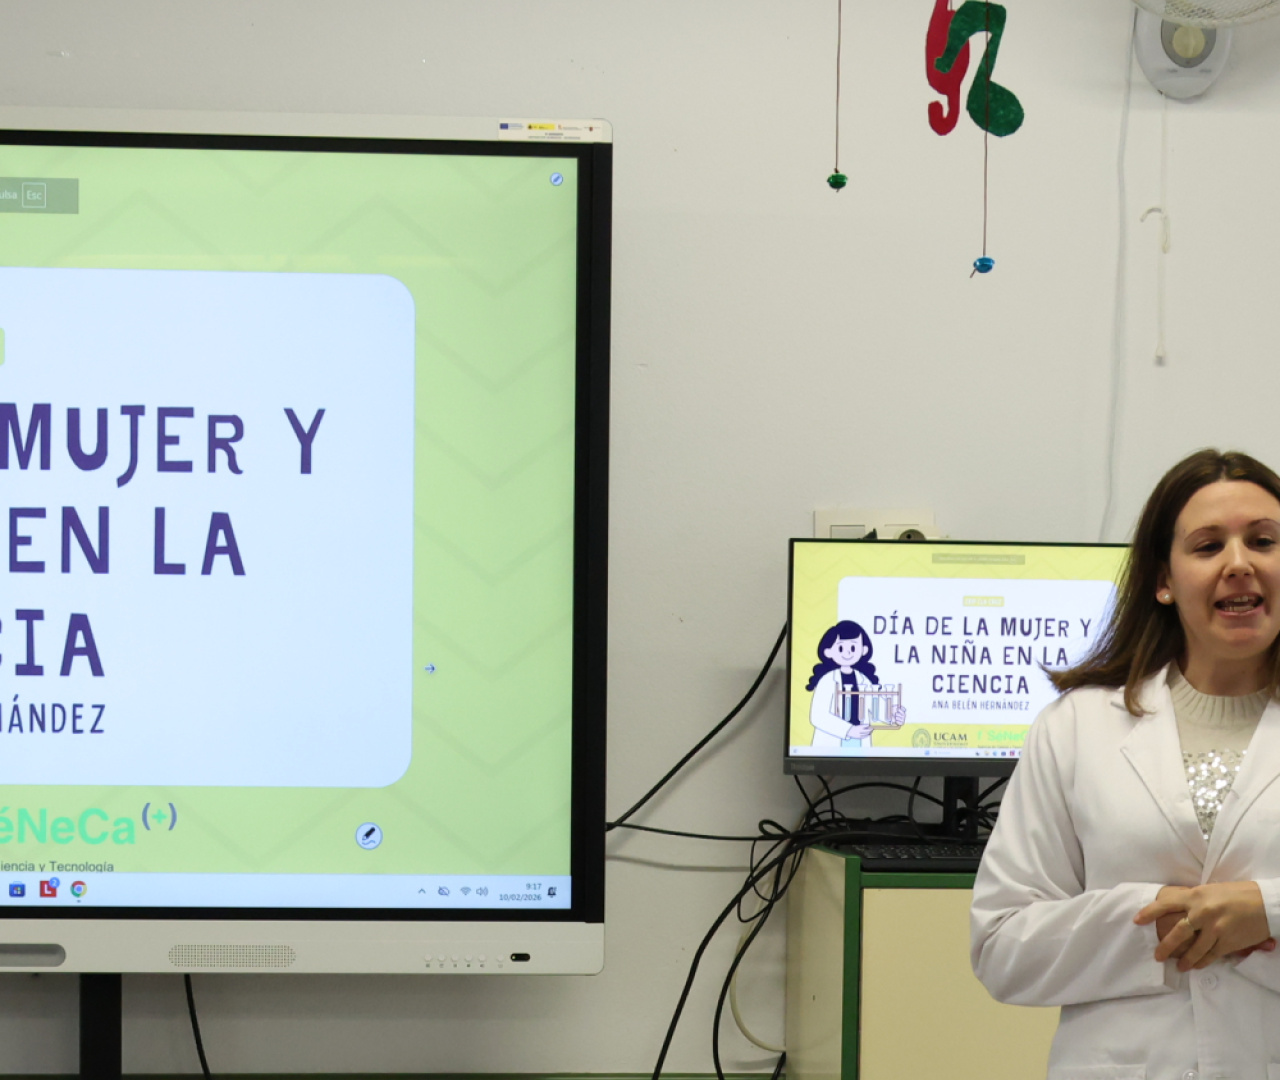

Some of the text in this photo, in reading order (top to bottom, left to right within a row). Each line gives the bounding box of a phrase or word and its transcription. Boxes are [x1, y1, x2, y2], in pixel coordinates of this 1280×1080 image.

[26, 190, 42, 201] Esc
[284, 408, 326, 475] Y
[8, 506, 111, 574] EN
[154, 506, 246, 576] LA
[873, 610, 1092, 641] DÍA DE LA MUJER Y
[894, 640, 1068, 667] LA NIÑA EN LA
[931, 674, 1029, 694] CIENCIA
[931, 697, 1030, 711] ANA BELÉN HERNÁNDEZ
[933, 732, 967, 741] UCAM
[49, 860, 115, 873] Tecnología
